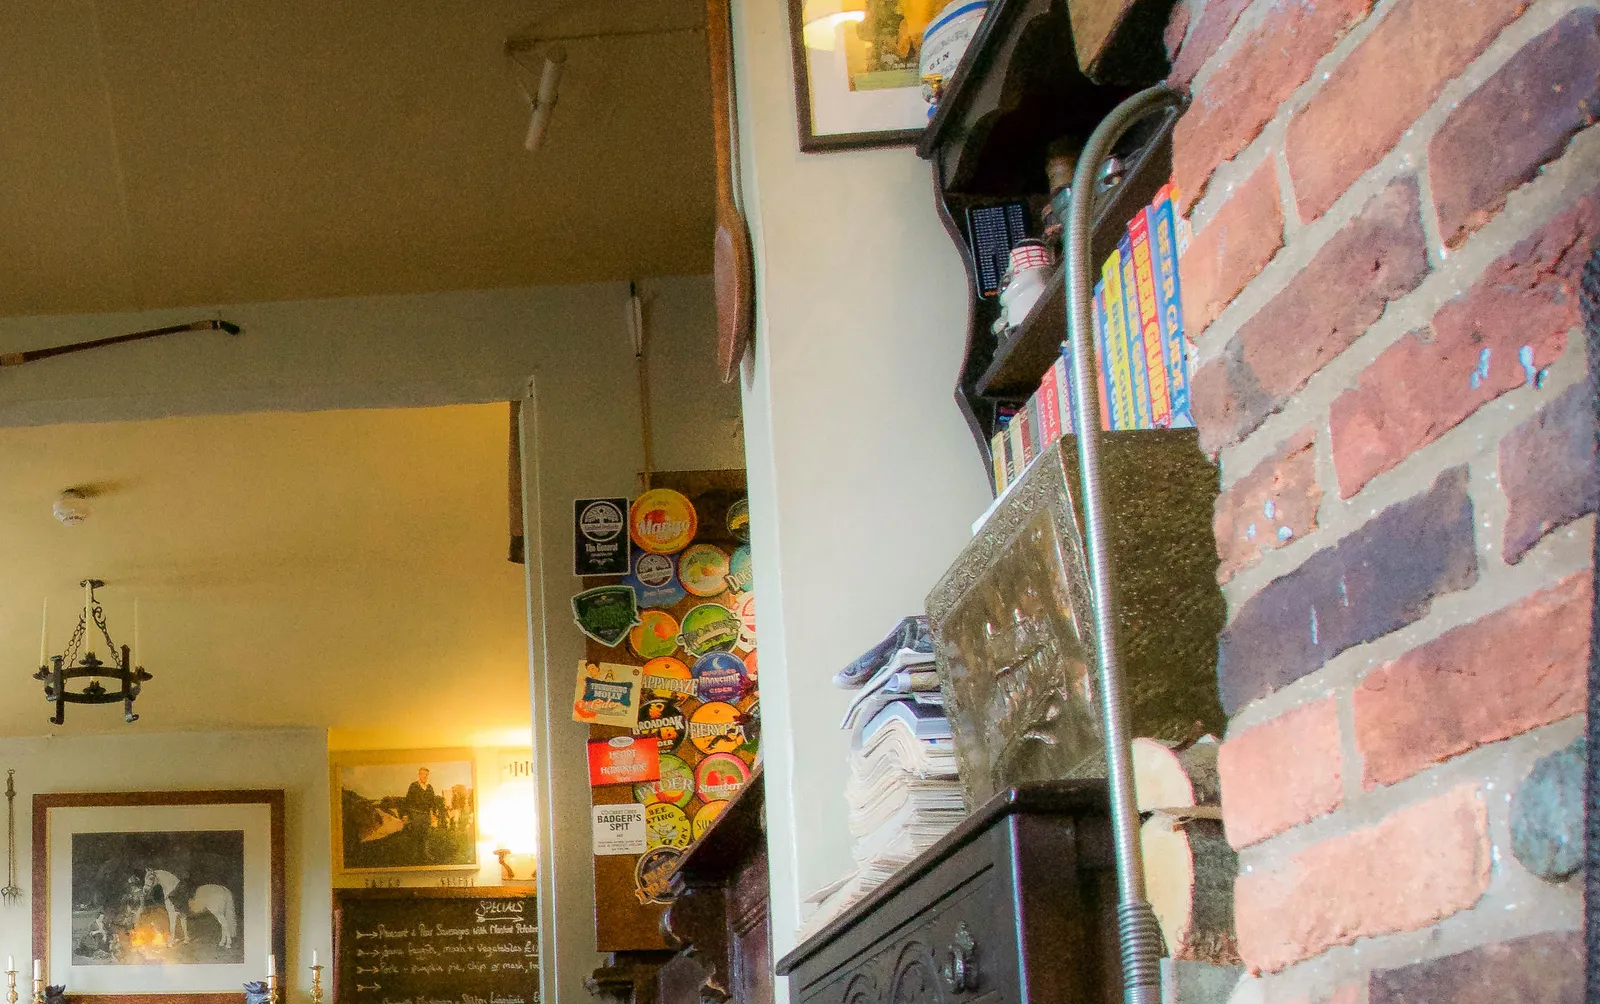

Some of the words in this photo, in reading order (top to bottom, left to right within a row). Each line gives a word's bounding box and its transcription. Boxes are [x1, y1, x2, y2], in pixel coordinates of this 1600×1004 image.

[929, 51, 950, 71] GIN
[1132, 239, 1157, 325] BEER
[1143, 321, 1169, 422] GUIDE
[642, 675, 668, 690] APPY
[669, 678, 700, 697] DAZE
[593, 690, 623, 700] MOLLY
[689, 721, 723, 740] FIERY
[657, 739, 674, 748] DER
[648, 806, 668, 816] BEE
[597, 813, 642, 824] BADGER'S
[609, 822, 631, 831] SPIT
[475, 900, 525, 917] SPECIALS
[472, 925, 488, 935] with
[467, 962, 487, 974] chips
